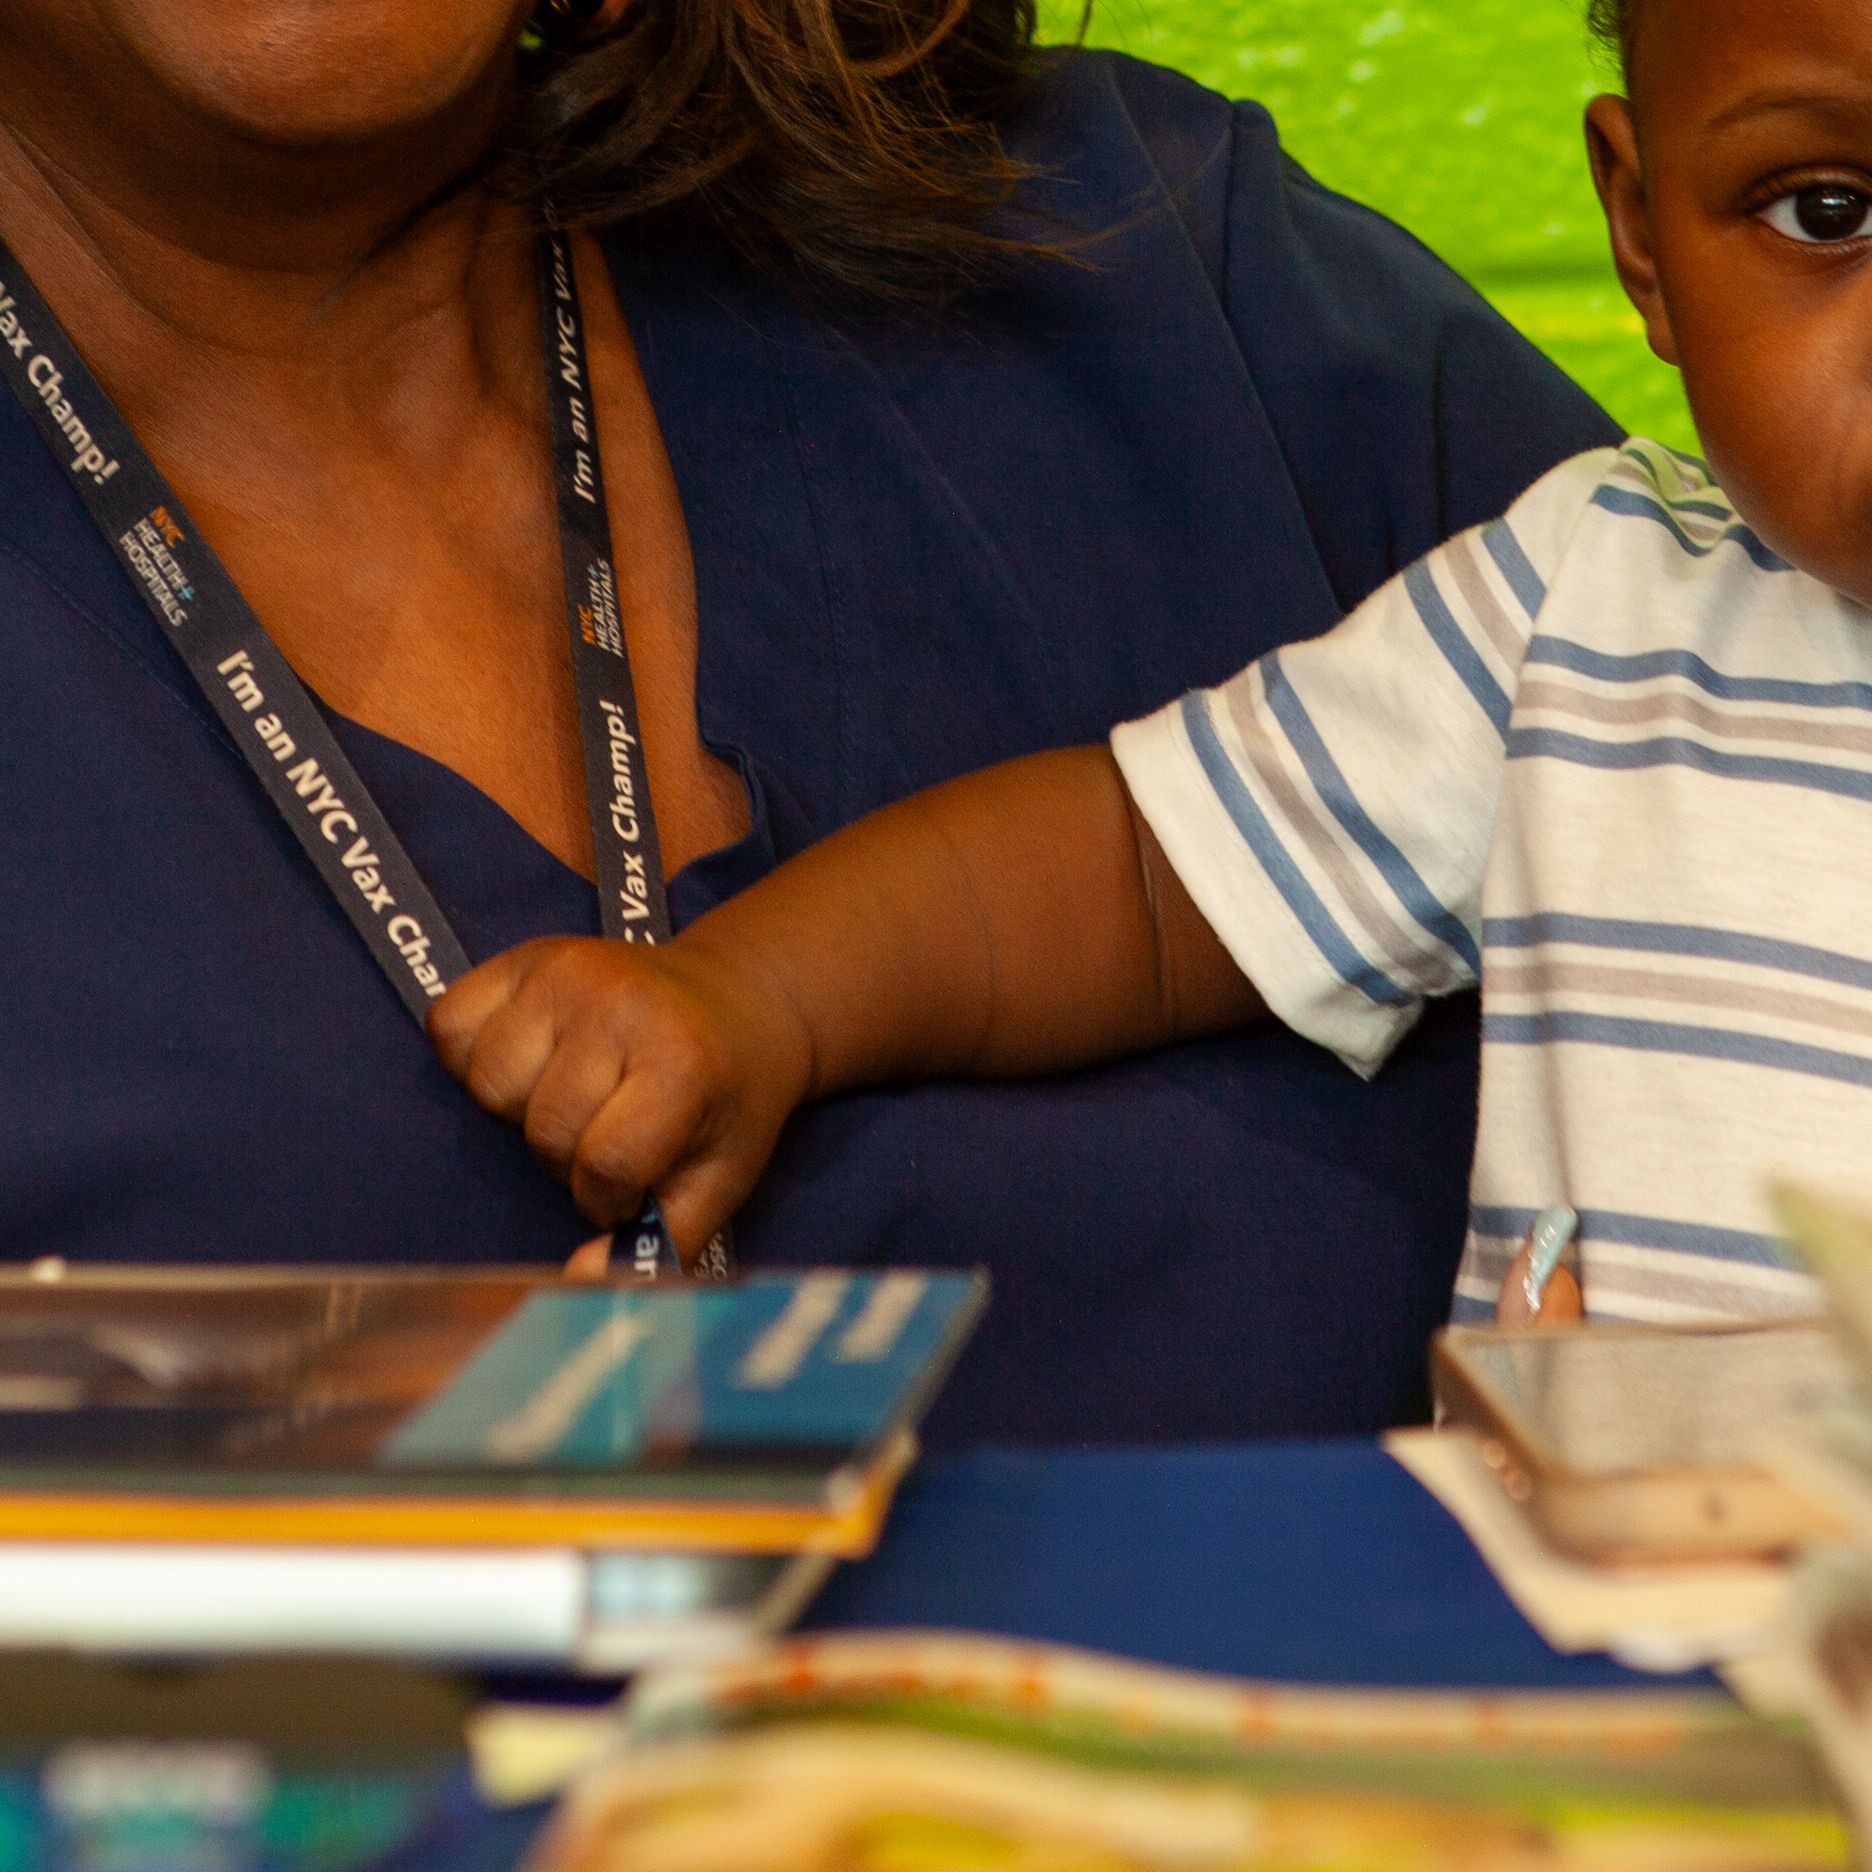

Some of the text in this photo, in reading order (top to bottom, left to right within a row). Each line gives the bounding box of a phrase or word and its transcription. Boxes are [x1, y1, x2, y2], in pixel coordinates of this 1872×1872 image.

[555, 305, 586, 392] NYC
[26, 354, 121, 486] Champ!
[570, 400, 595, 437] an
[574, 455, 596, 505] I'm
[149, 505, 186, 548] NYC
[119, 531, 189, 627] HOSPITALS
[596, 556, 625, 659] HOSPITALS
[217, 649, 264, 713] I'm
[254, 712, 296, 762] an
[286, 758, 359, 844] NYC
[340, 836, 398, 914] Vax
[599, 698, 639, 843] Champ!
[621, 851, 649, 922] Vax
